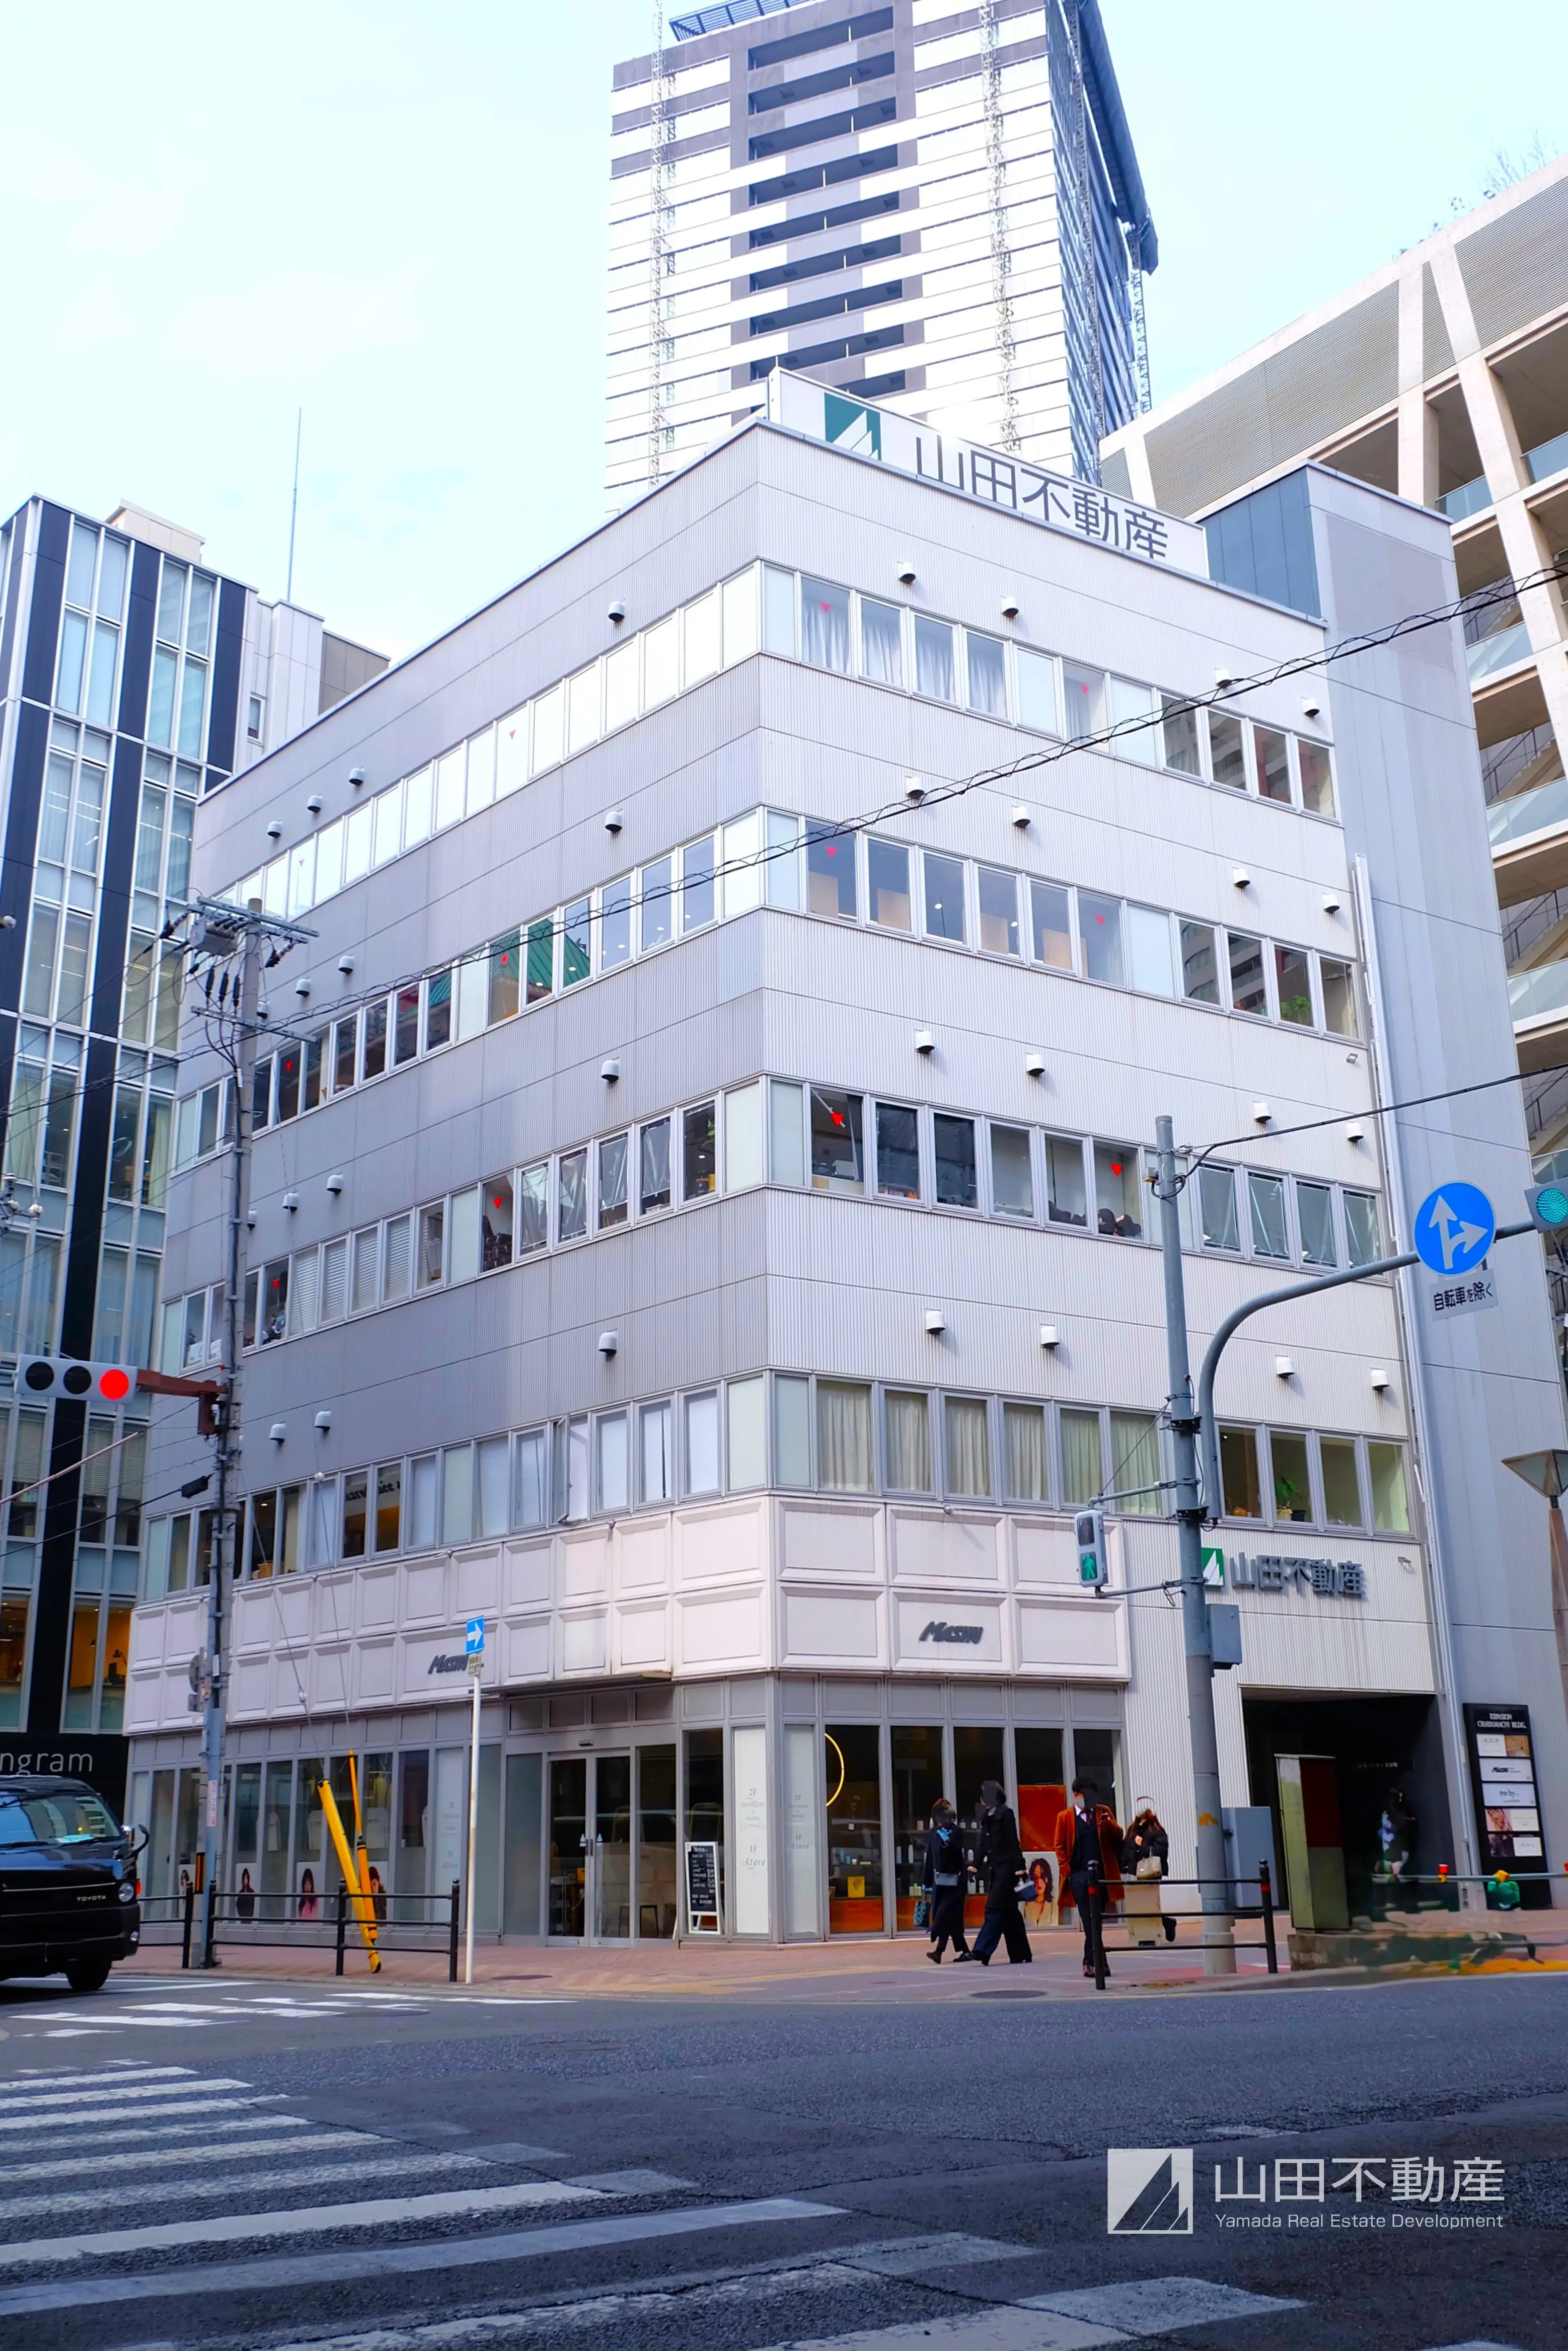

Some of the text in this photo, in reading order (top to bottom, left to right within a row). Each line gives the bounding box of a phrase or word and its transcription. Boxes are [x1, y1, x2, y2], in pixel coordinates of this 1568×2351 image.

[916, 436, 1168, 559] 山田不動産
[1433, 1281, 1494, 1312] 自転車を除く
[1230, 1552, 1364, 1598] 山田不動産
[0, 1753, 93, 1776] ngram
[749, 1788, 757, 1796] 2F
